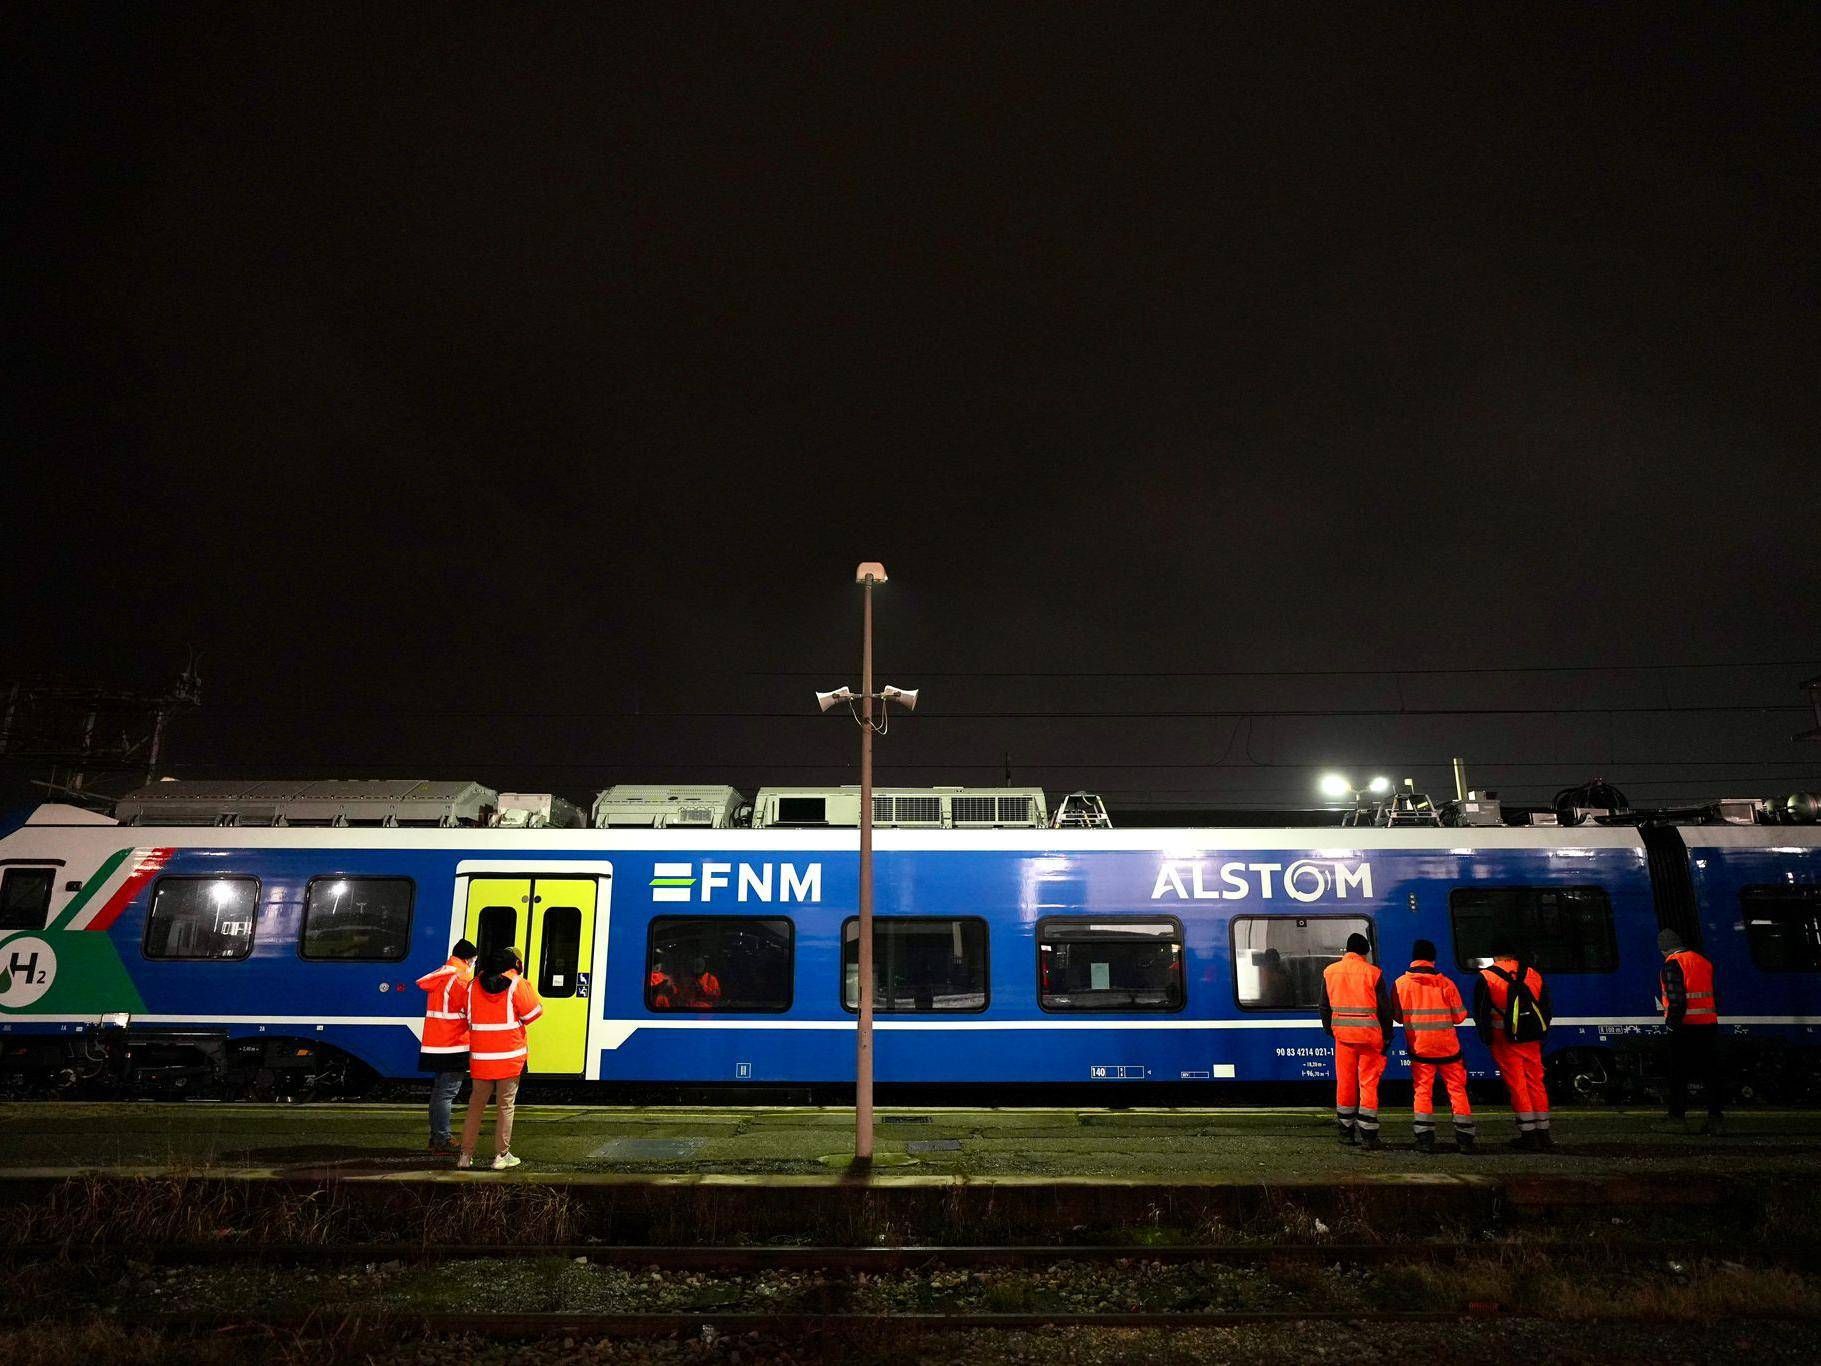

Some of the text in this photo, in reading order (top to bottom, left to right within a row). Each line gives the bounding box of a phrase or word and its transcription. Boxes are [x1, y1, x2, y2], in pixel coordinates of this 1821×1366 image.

[701, 862, 822, 902] FNM
[1151, 859, 1374, 903] ALSTOM
[1276, 1047, 1286, 1057] 90
[1286, 1047, 1296, 1057] 83
[1296, 1047, 1314, 1057] 4214
[1092, 1067, 1106, 1077] 140
